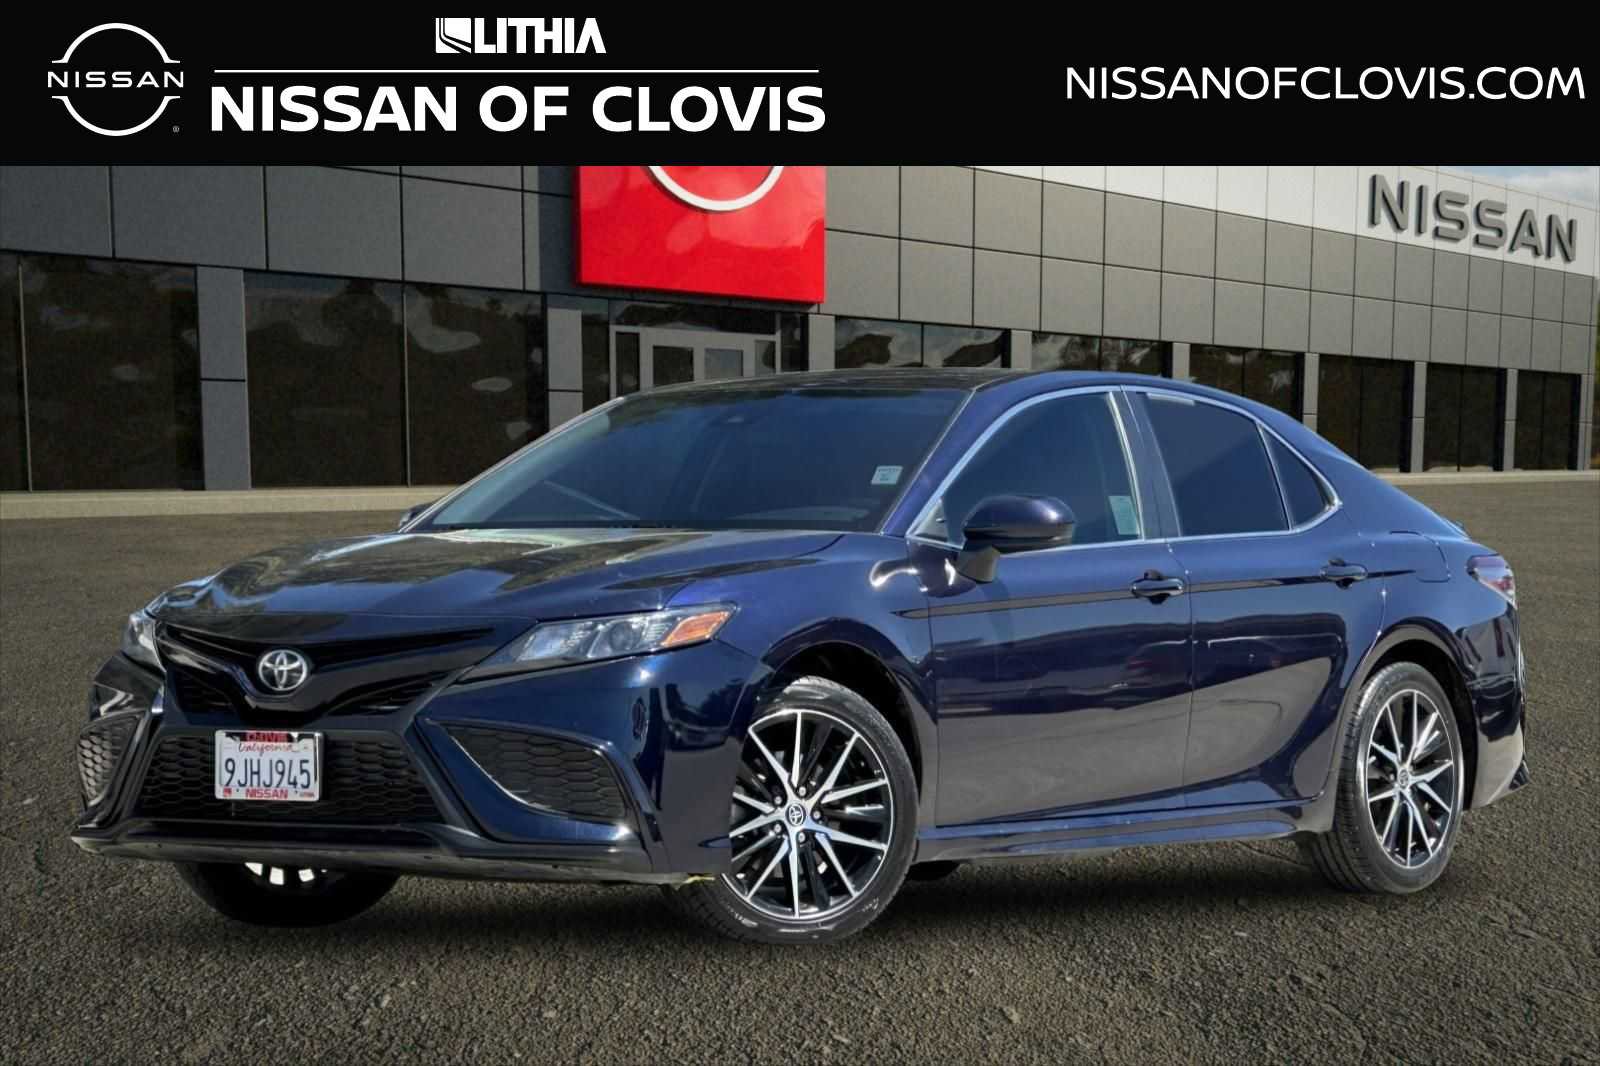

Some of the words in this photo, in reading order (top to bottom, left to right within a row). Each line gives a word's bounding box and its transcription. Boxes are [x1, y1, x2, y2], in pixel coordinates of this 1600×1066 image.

[1368, 174, 1577, 263] NISSAN
[224, 758, 311, 789] 9JHJ945
[245, 788, 289, 799] NISSAN
